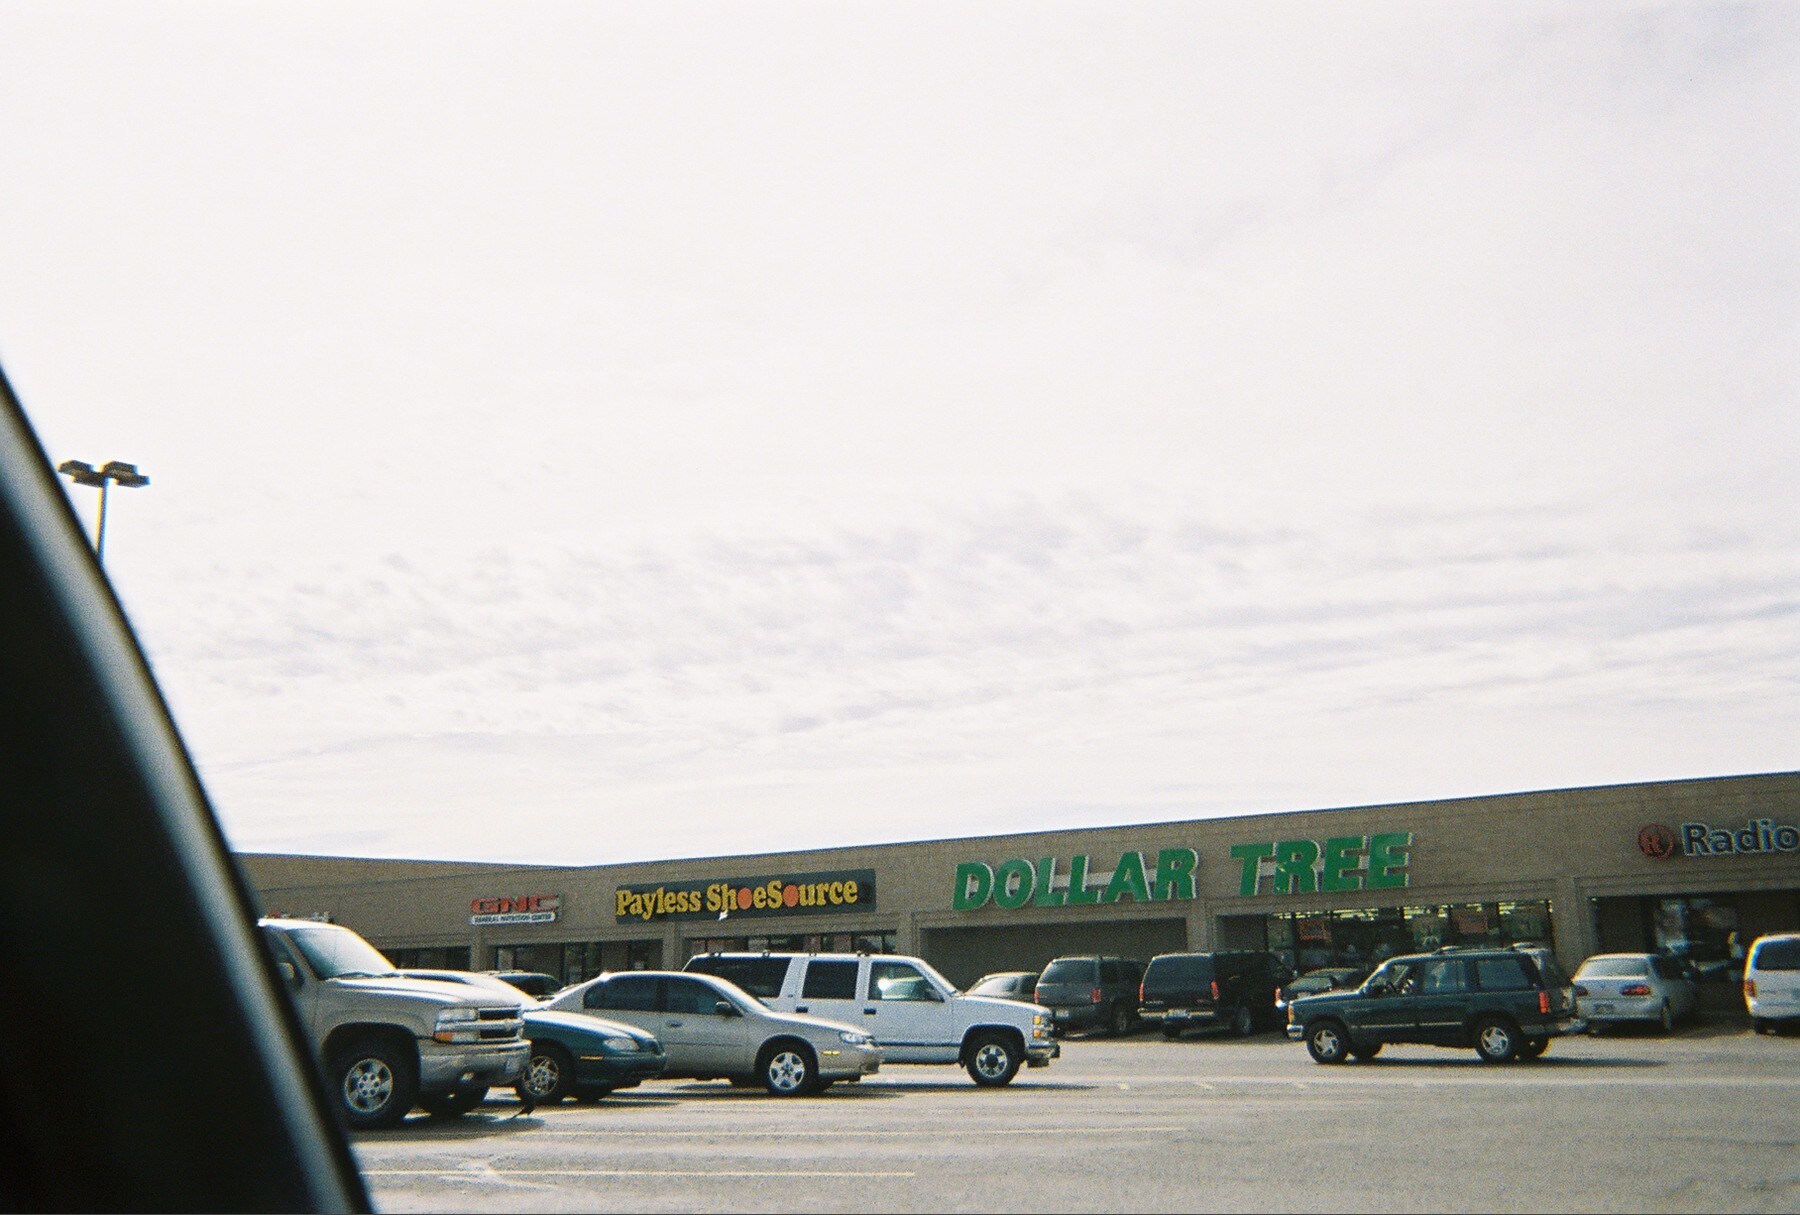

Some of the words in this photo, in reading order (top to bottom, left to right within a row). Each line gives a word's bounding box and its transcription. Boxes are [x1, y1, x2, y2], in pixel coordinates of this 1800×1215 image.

[1681, 818, 1800, 856] Radio
[952, 847, 1199, 912] DOLLAR
[1230, 831, 1413, 896] TREE
[470, 894, 559, 913] GNC
[615, 887, 701, 920] Payless
[706, 880, 858, 912] ShoeSource
